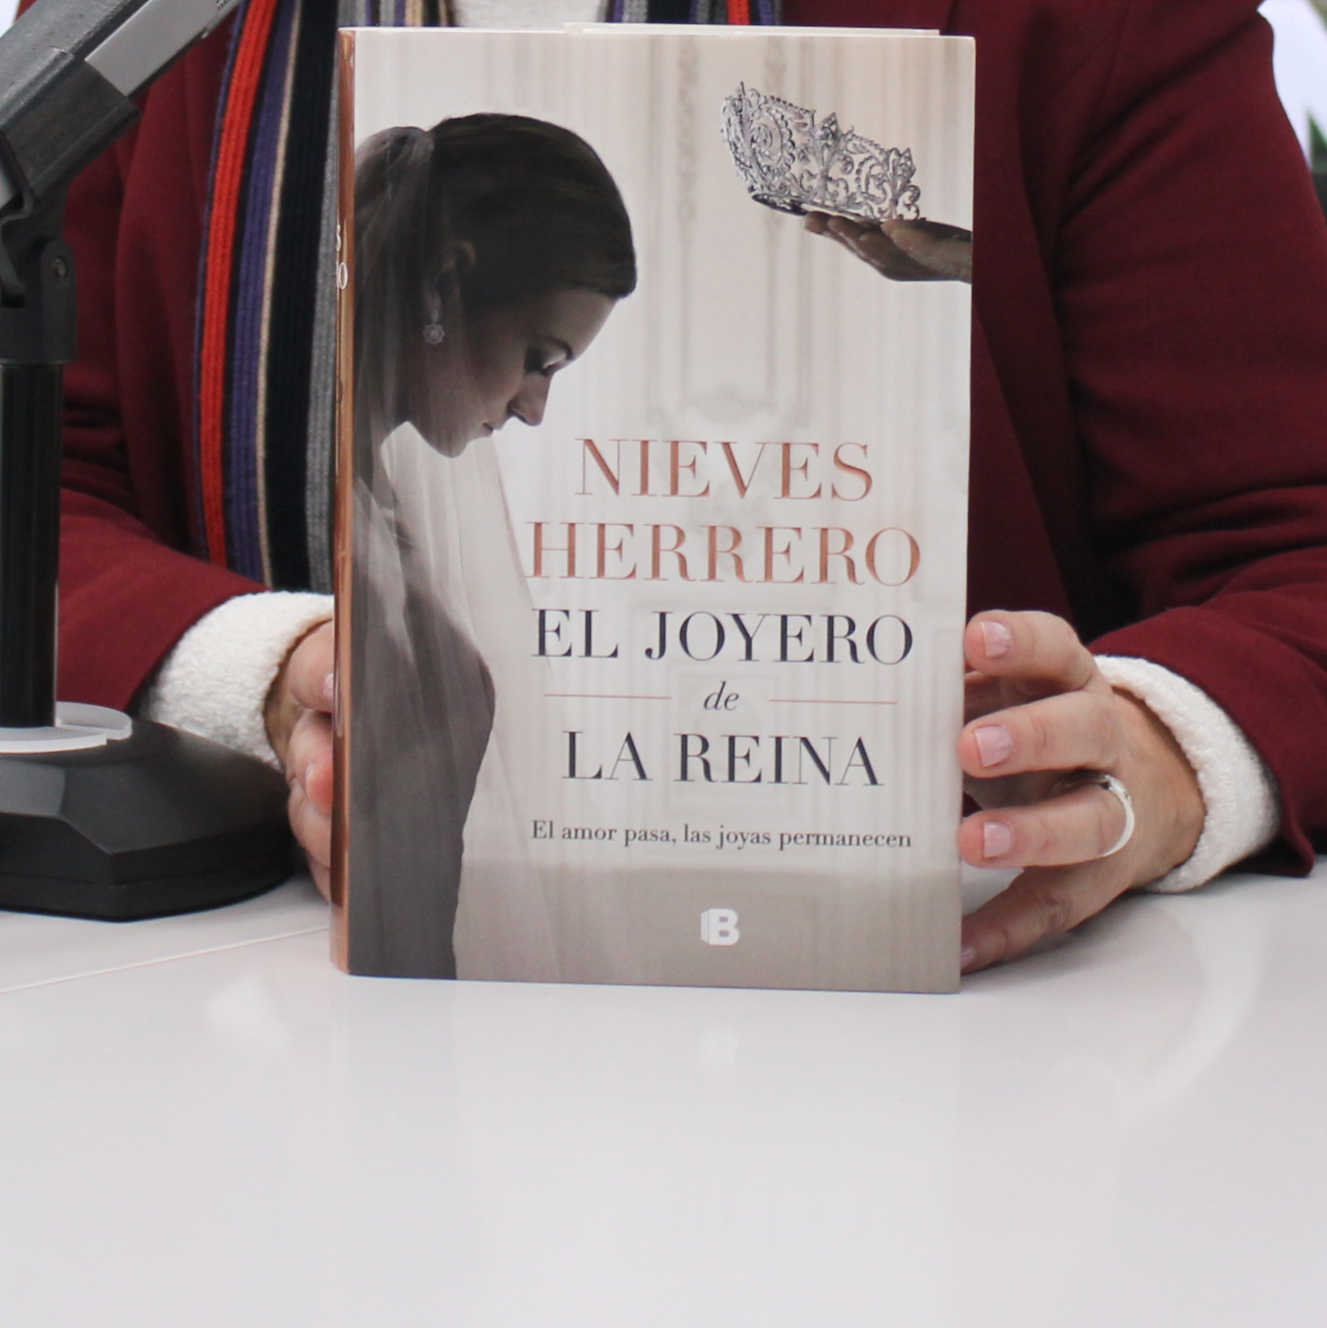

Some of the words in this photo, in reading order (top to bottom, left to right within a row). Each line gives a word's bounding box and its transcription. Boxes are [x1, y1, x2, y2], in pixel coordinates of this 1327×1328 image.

[574, 438, 873, 502] NIEVES
[525, 522, 921, 587] HERRERO
[531, 609, 619, 659] EL
[644, 611, 914, 665] JOYERO
[703, 682, 740, 712] de
[561, 731, 653, 781] LA
[674, 734, 884, 786] REINA
[532, 820, 554, 840] El
[561, 826, 617, 841] amor
[623, 826, 677, 848] pasa,
[683, 823, 712, 843] las
[716, 825, 771, 850] joyas
[779, 831, 912, 851] permanecen
